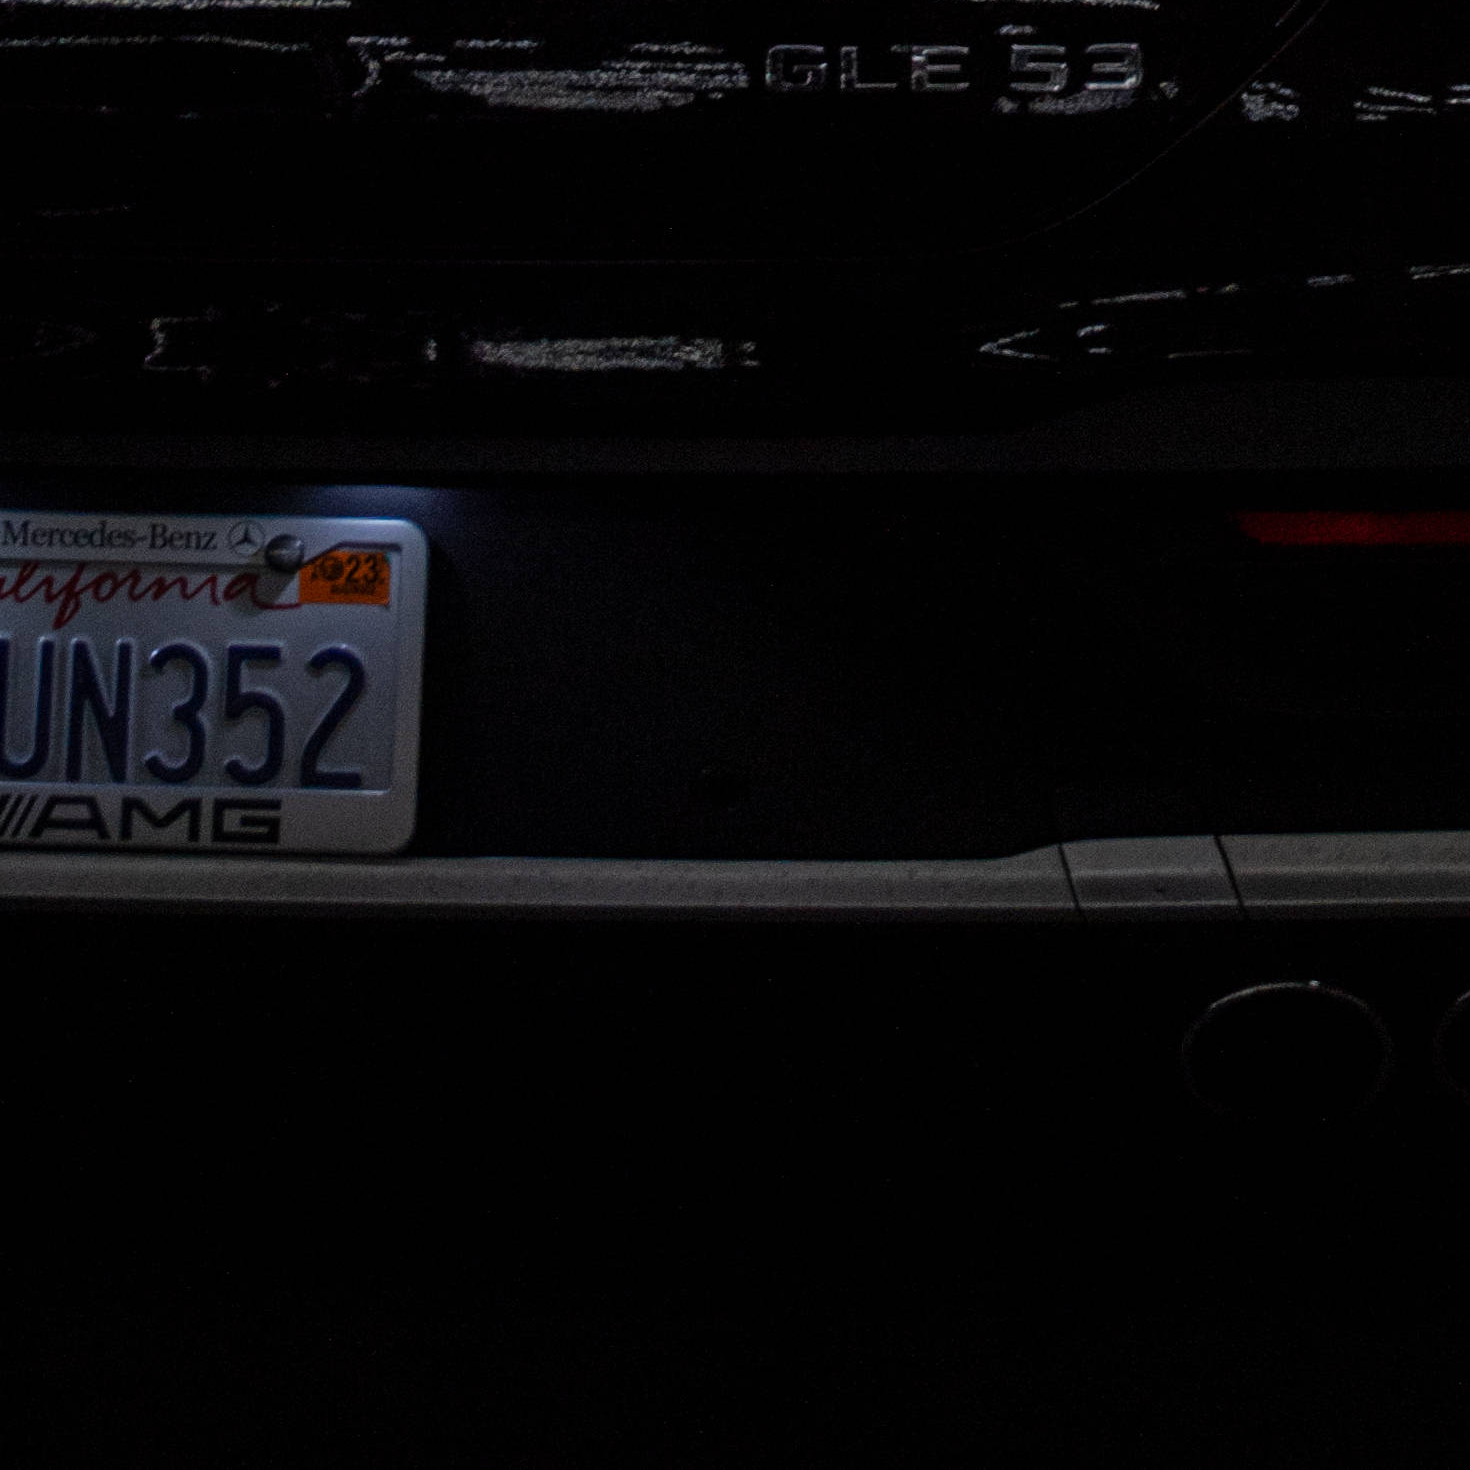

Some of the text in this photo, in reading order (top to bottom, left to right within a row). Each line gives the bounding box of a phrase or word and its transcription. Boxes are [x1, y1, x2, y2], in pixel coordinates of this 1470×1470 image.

[765, 43, 1143, 92] GLE 53
[2, 520, 218, 551] Mercedes-Benz
[0, 637, 366, 790] UN352
